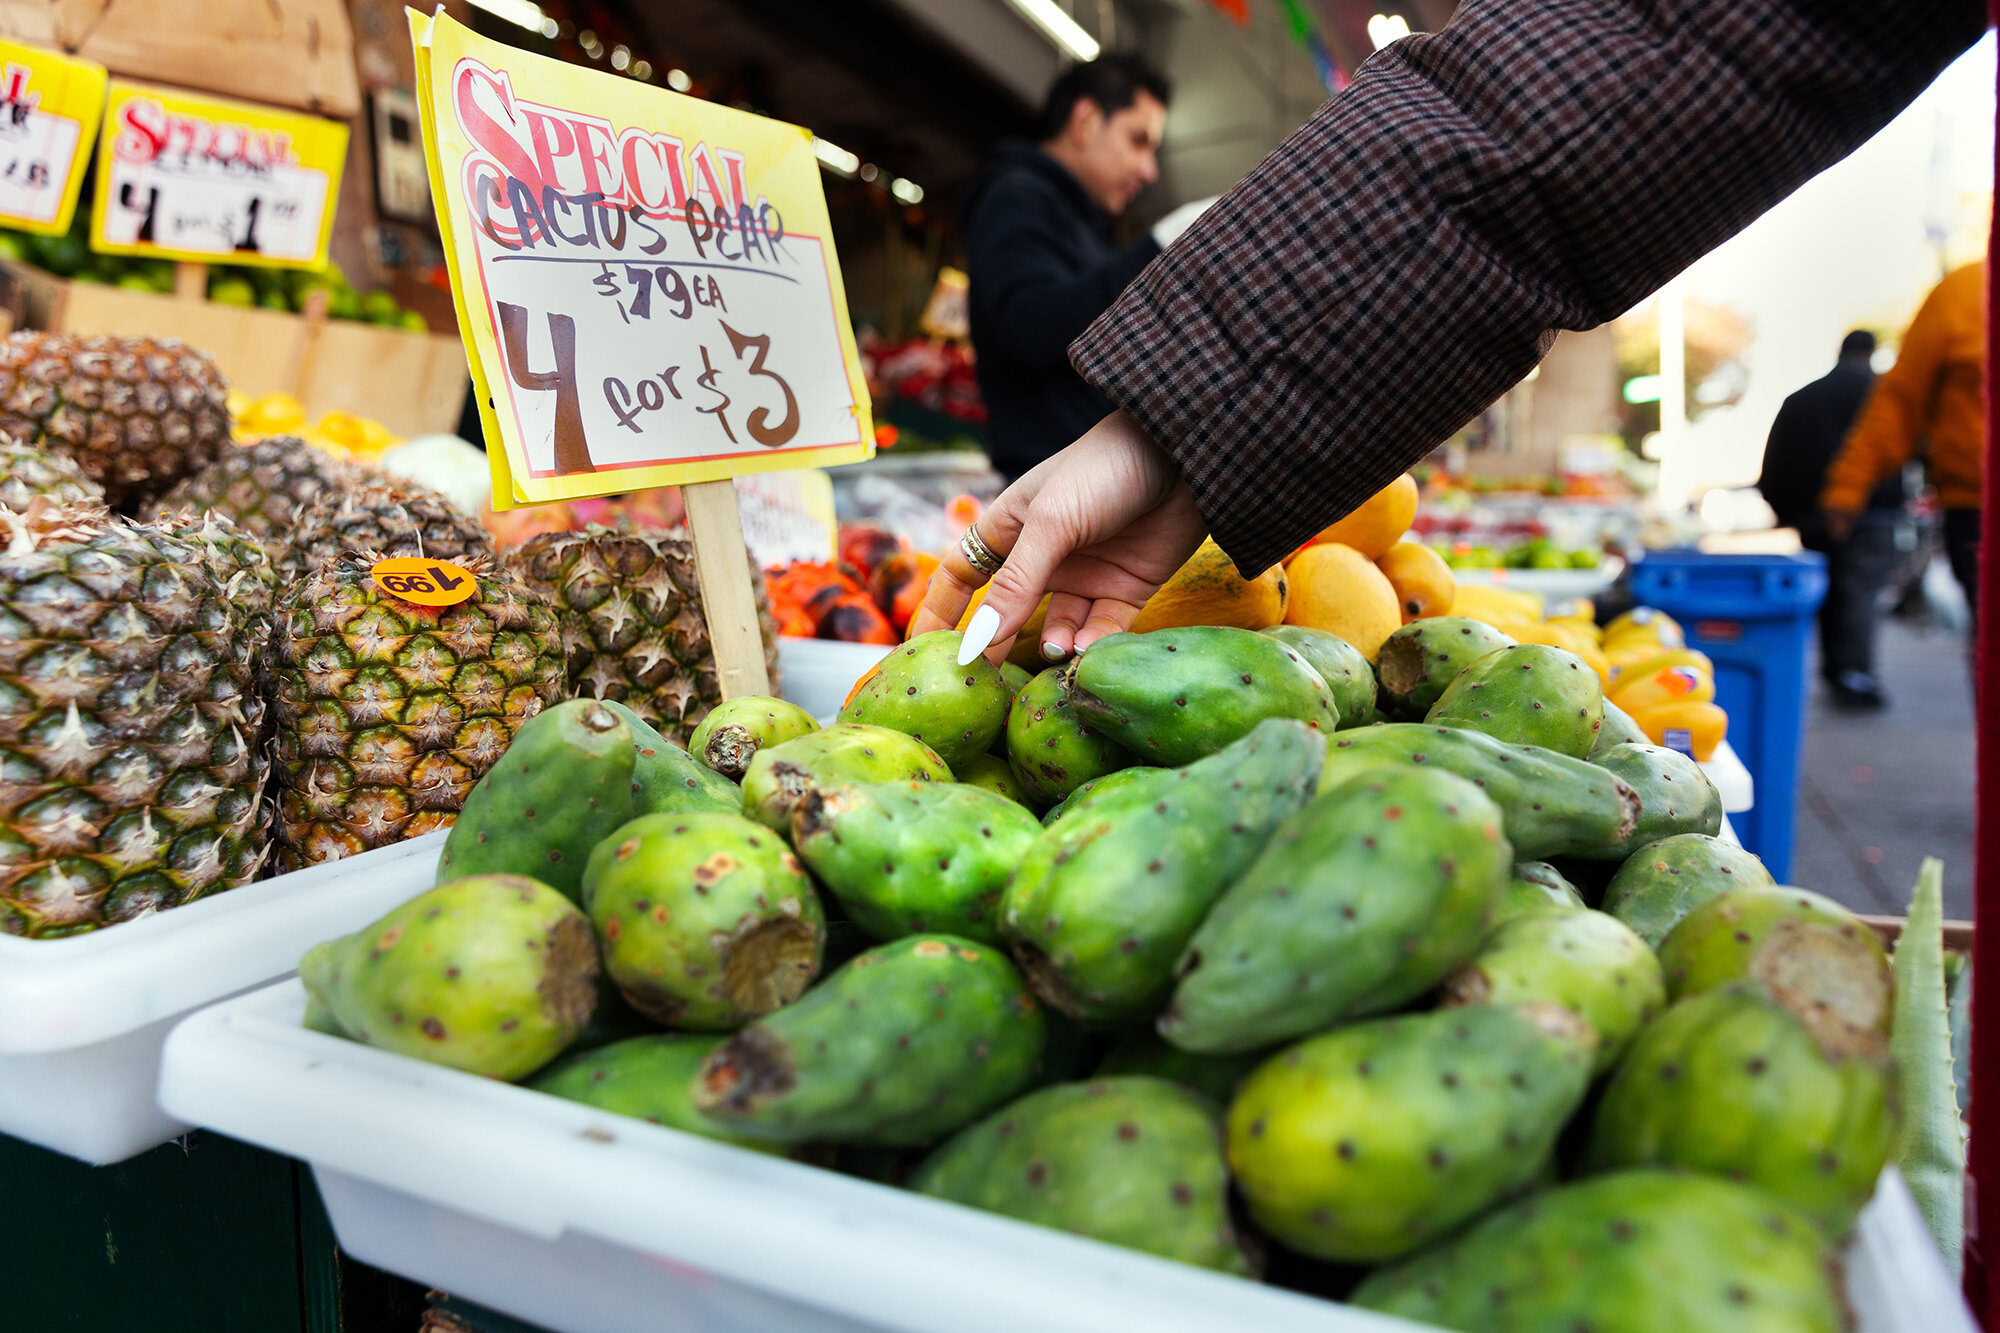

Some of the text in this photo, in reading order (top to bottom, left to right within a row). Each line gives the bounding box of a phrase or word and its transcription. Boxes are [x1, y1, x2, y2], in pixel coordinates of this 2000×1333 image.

[120, 182, 158, 242] 4
[453, 57, 768, 246] SPECIAL
[475, 174, 798, 265] CACTUS PEAR
[497, 300, 597, 475] 4
[602, 365, 682, 434] for
